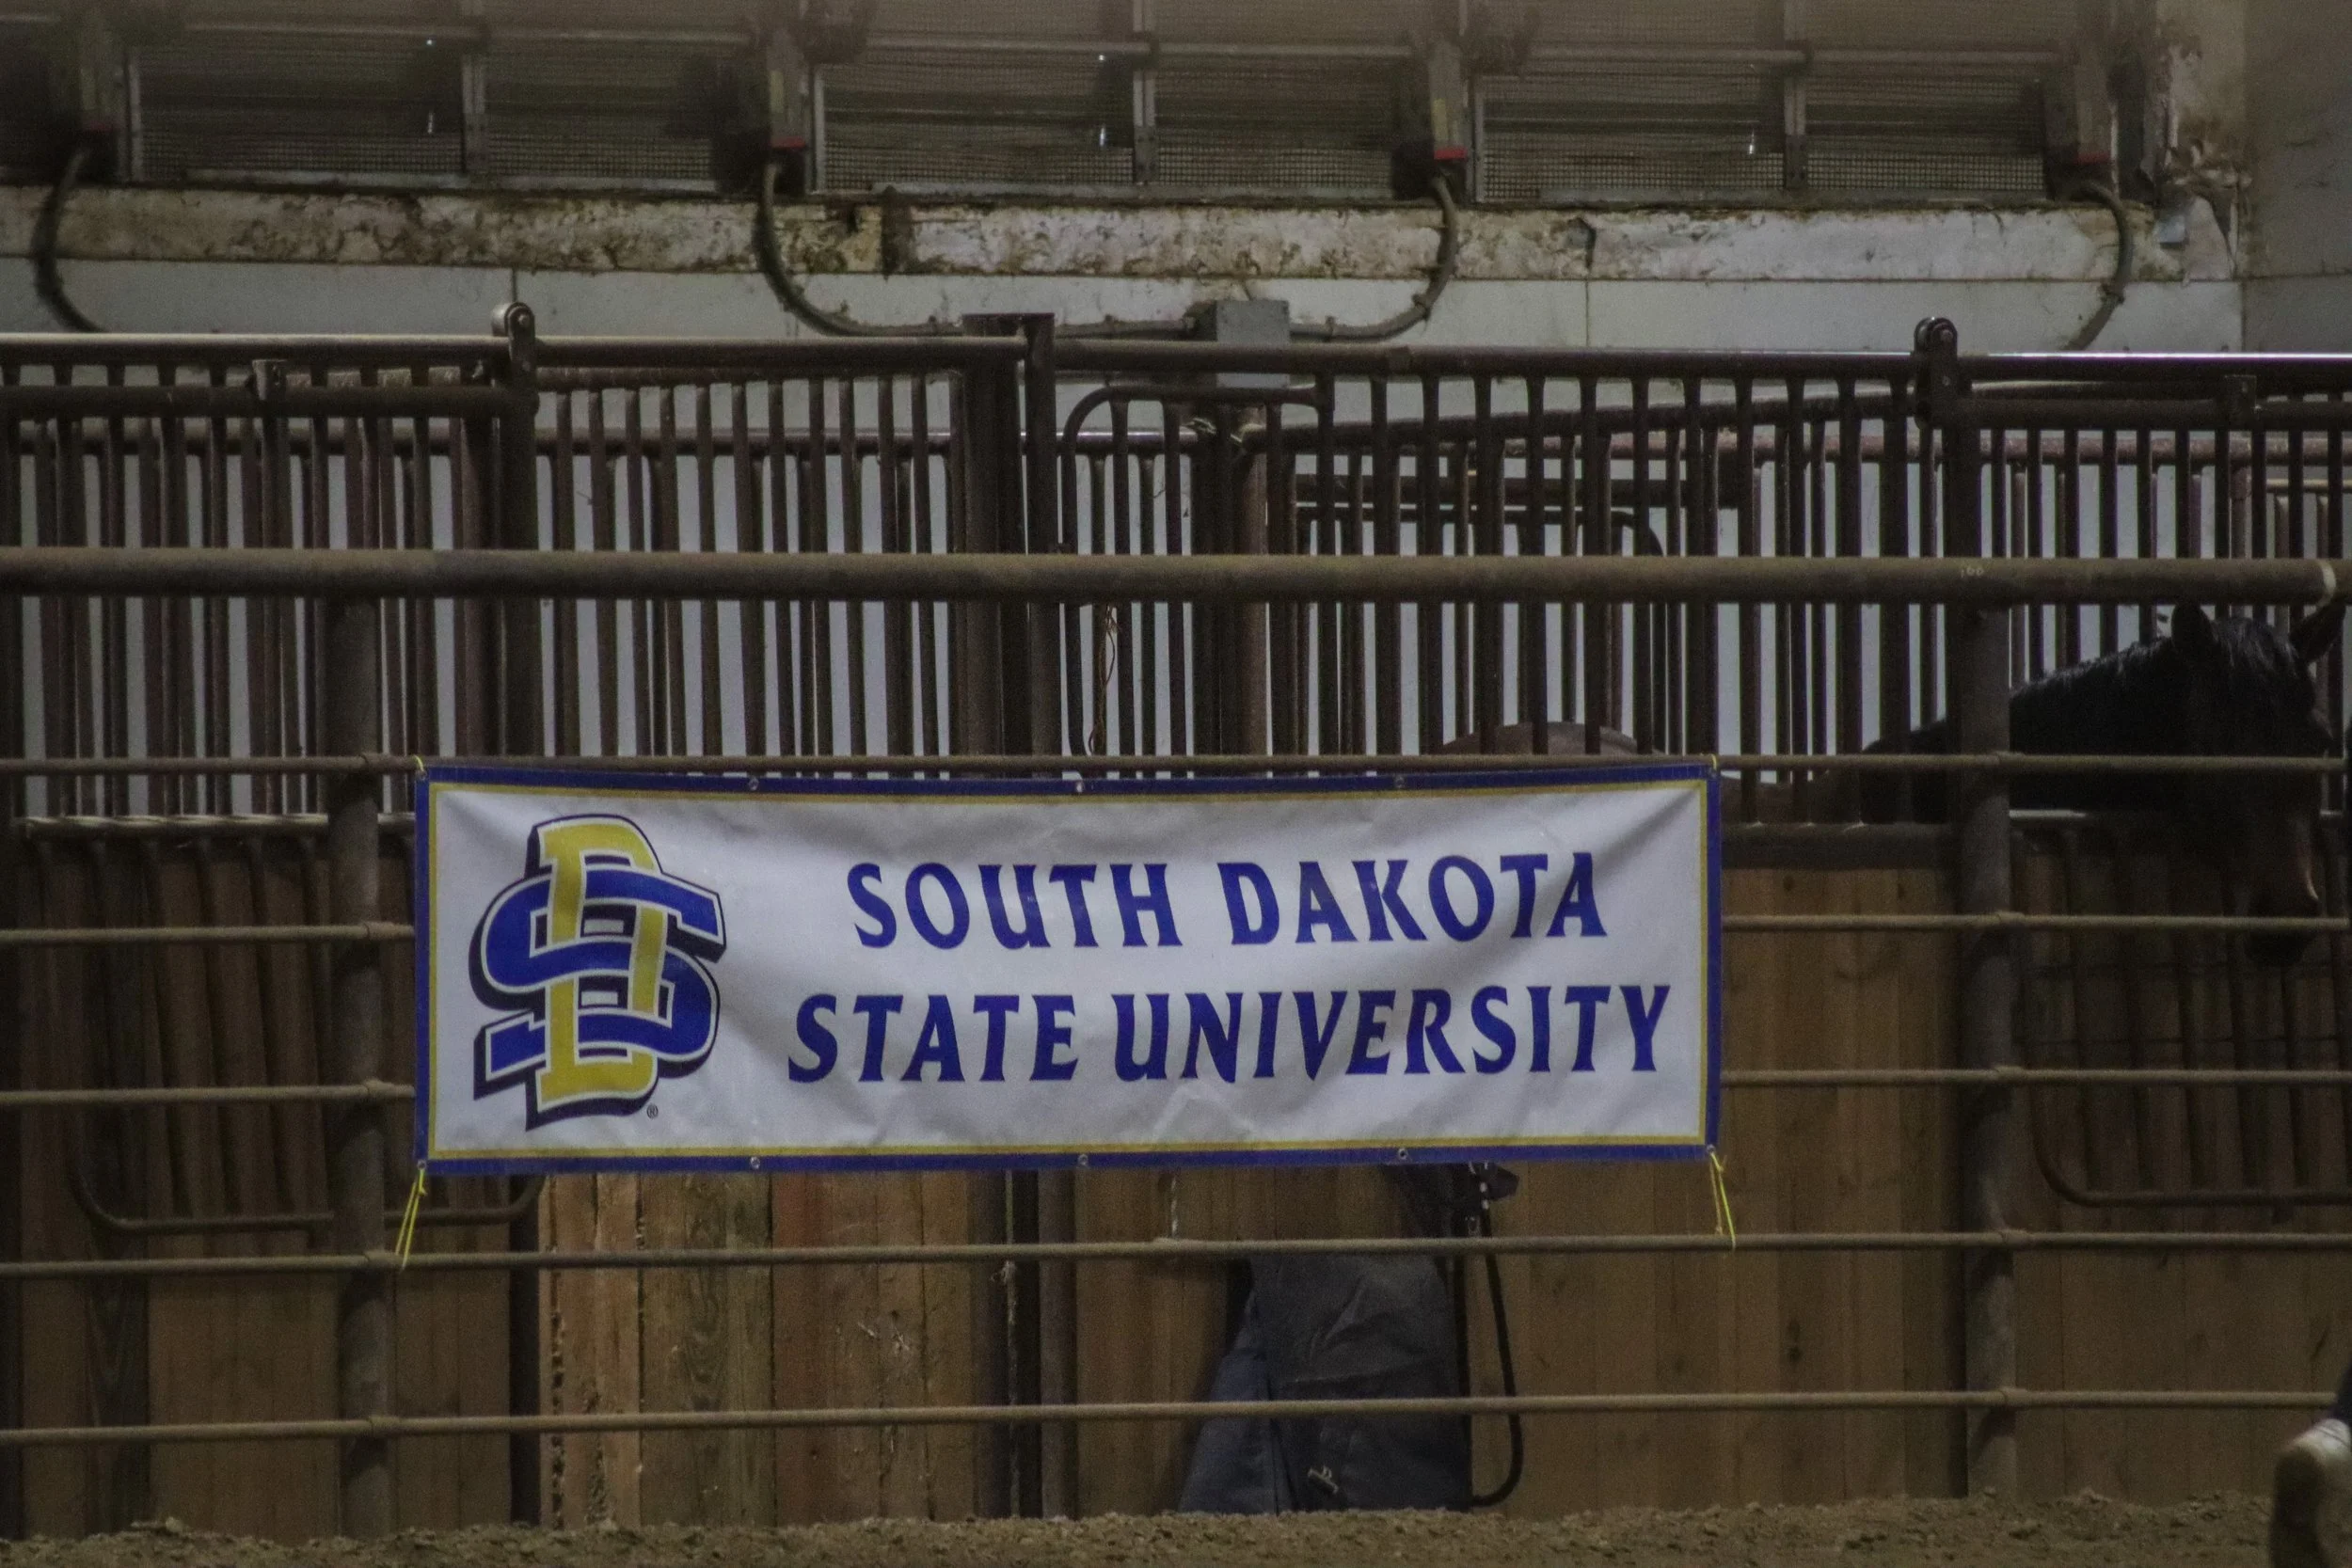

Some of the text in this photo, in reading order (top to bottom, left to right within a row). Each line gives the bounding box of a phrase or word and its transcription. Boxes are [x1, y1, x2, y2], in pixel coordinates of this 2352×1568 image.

[847, 852, 1608, 950] SOUTH DAKOTA
[787, 985, 1671, 1084] STATE UNIVERSITY
